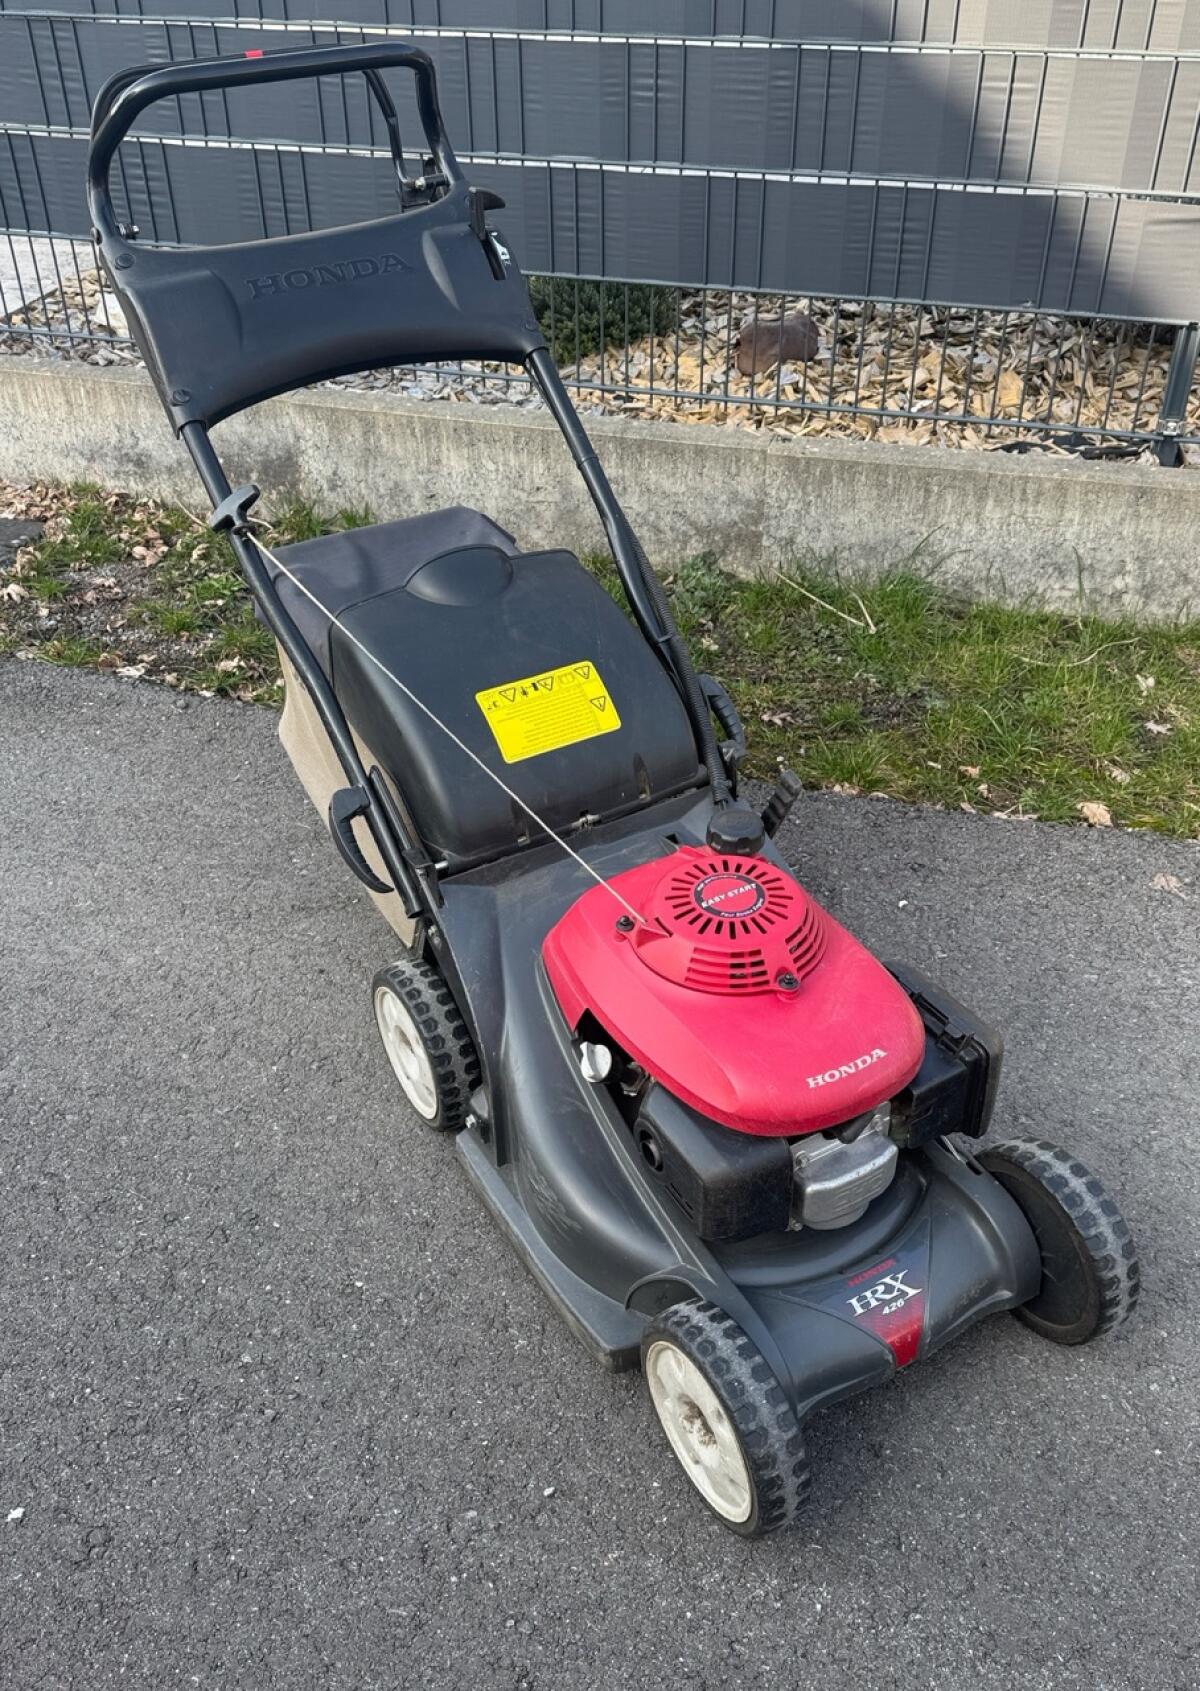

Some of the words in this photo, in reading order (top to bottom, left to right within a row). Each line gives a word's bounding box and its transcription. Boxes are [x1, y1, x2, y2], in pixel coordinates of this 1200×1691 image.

[245, 253, 414, 300] HONDA
[701, 894, 725, 908] EASY
[727, 883, 756, 897] START
[806, 1048, 887, 1088] HONDA
[846, 1269, 923, 1317] HRX
